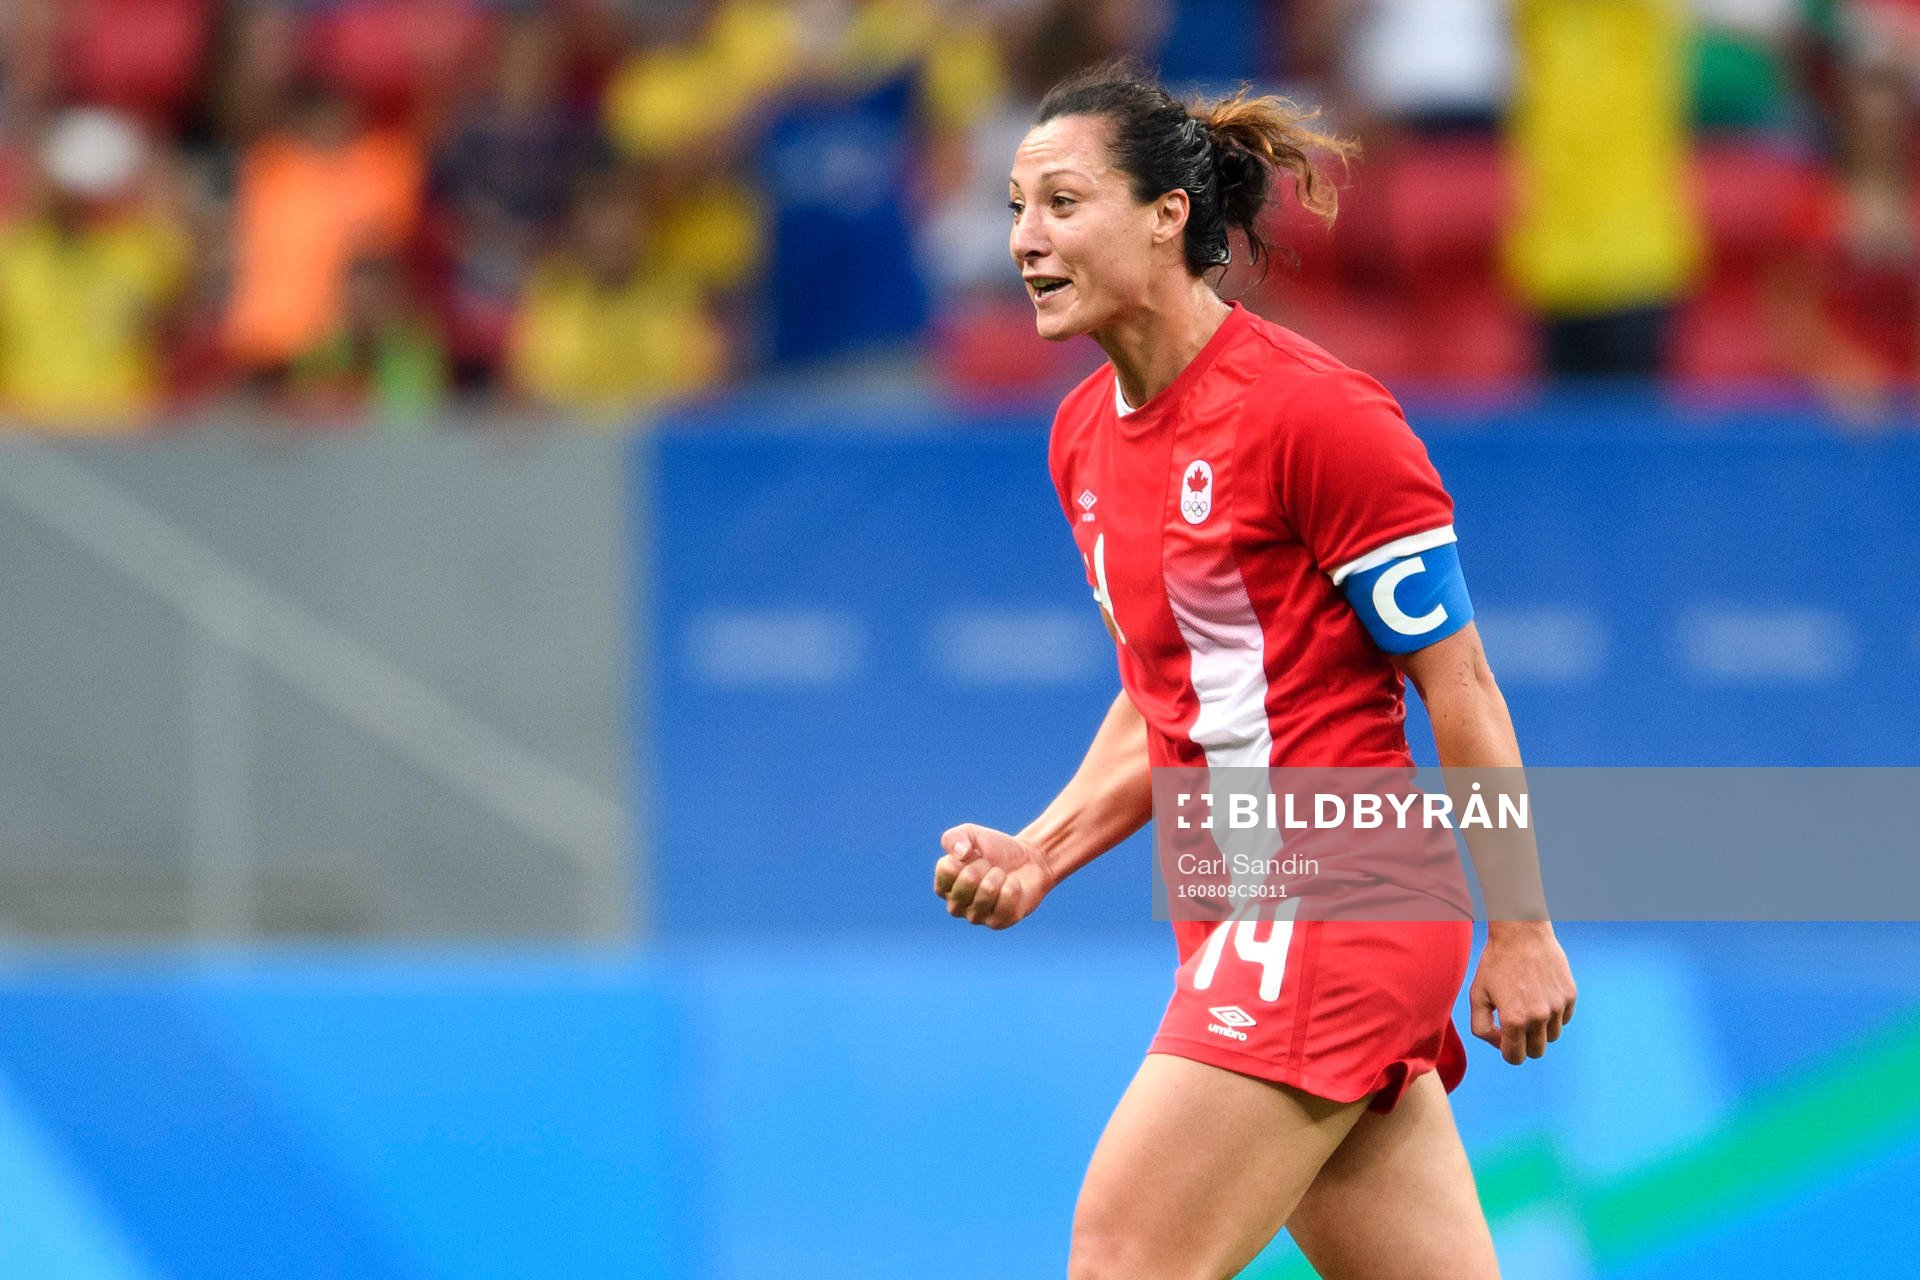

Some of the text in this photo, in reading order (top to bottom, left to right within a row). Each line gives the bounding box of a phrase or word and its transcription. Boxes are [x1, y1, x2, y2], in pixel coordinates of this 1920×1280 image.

[1373, 556, 1448, 635] C
[1193, 896, 1302, 1002] 14
[1208, 1023, 1248, 1042] umbro
